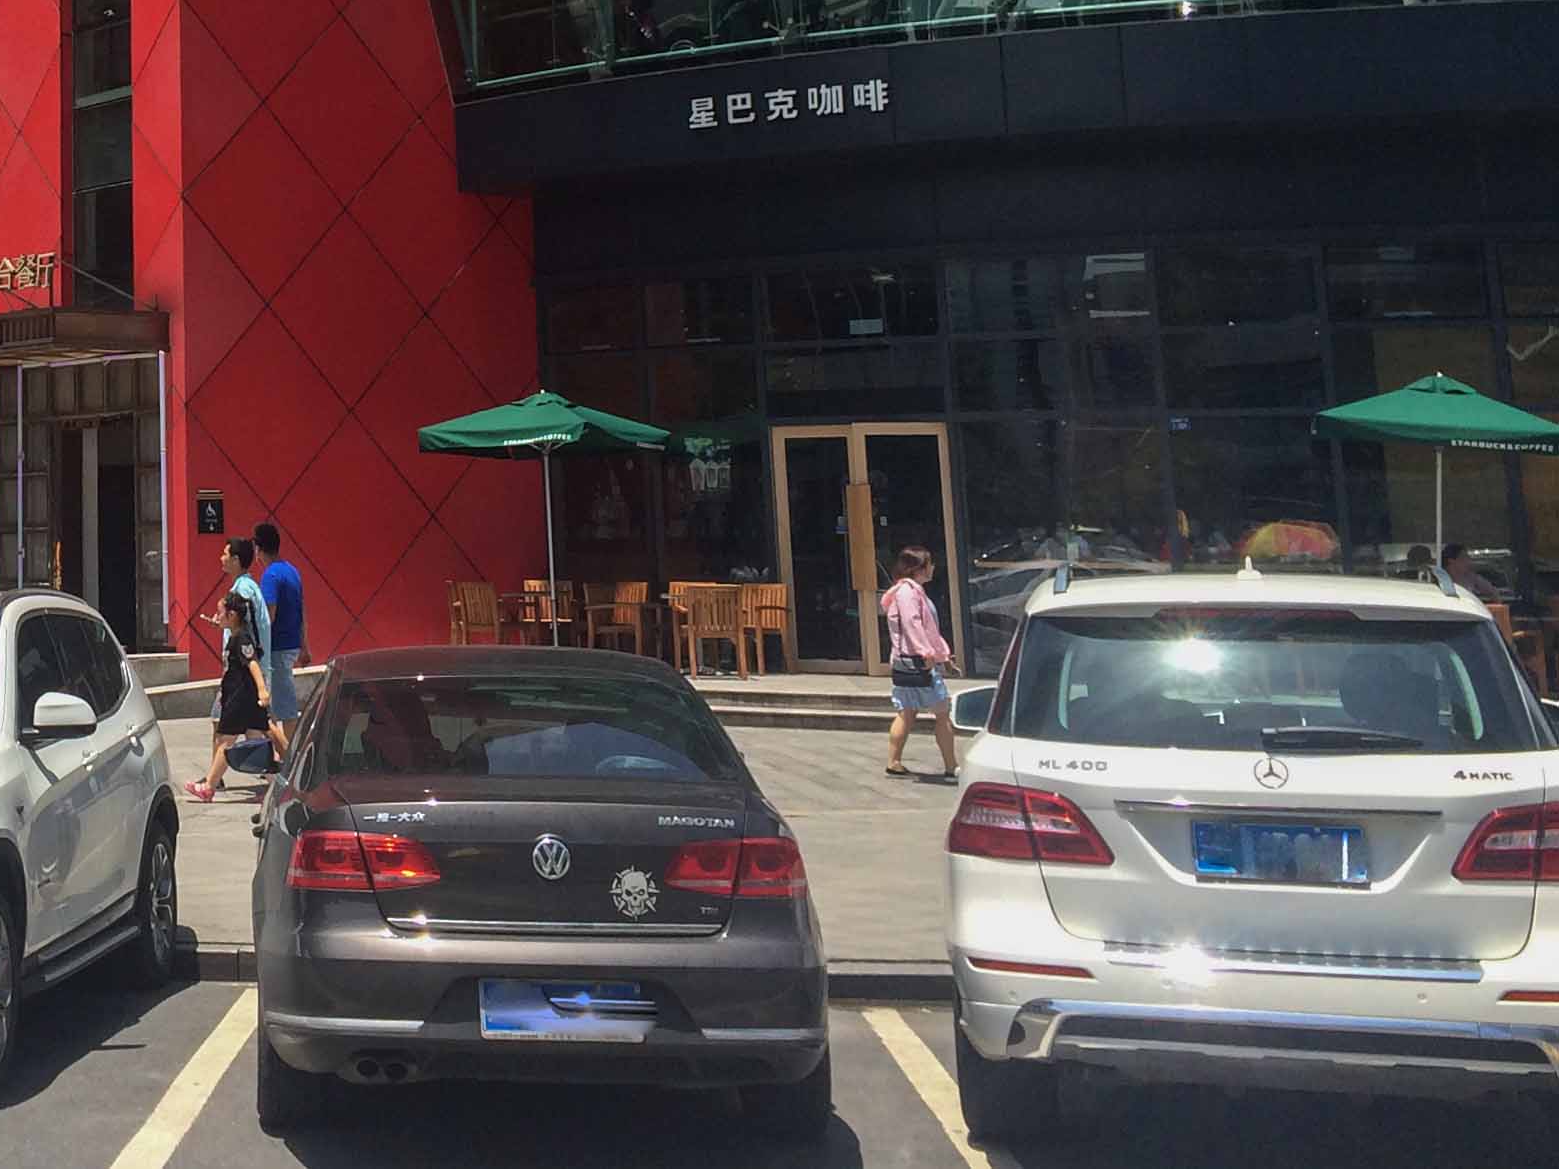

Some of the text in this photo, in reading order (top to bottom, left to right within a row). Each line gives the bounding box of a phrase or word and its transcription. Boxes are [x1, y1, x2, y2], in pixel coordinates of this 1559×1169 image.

[689, 78, 889, 129] 星巴克咖啡
[1038, 759, 1108, 771] ML 400
[657, 815, 736, 828] MAGOTAN
